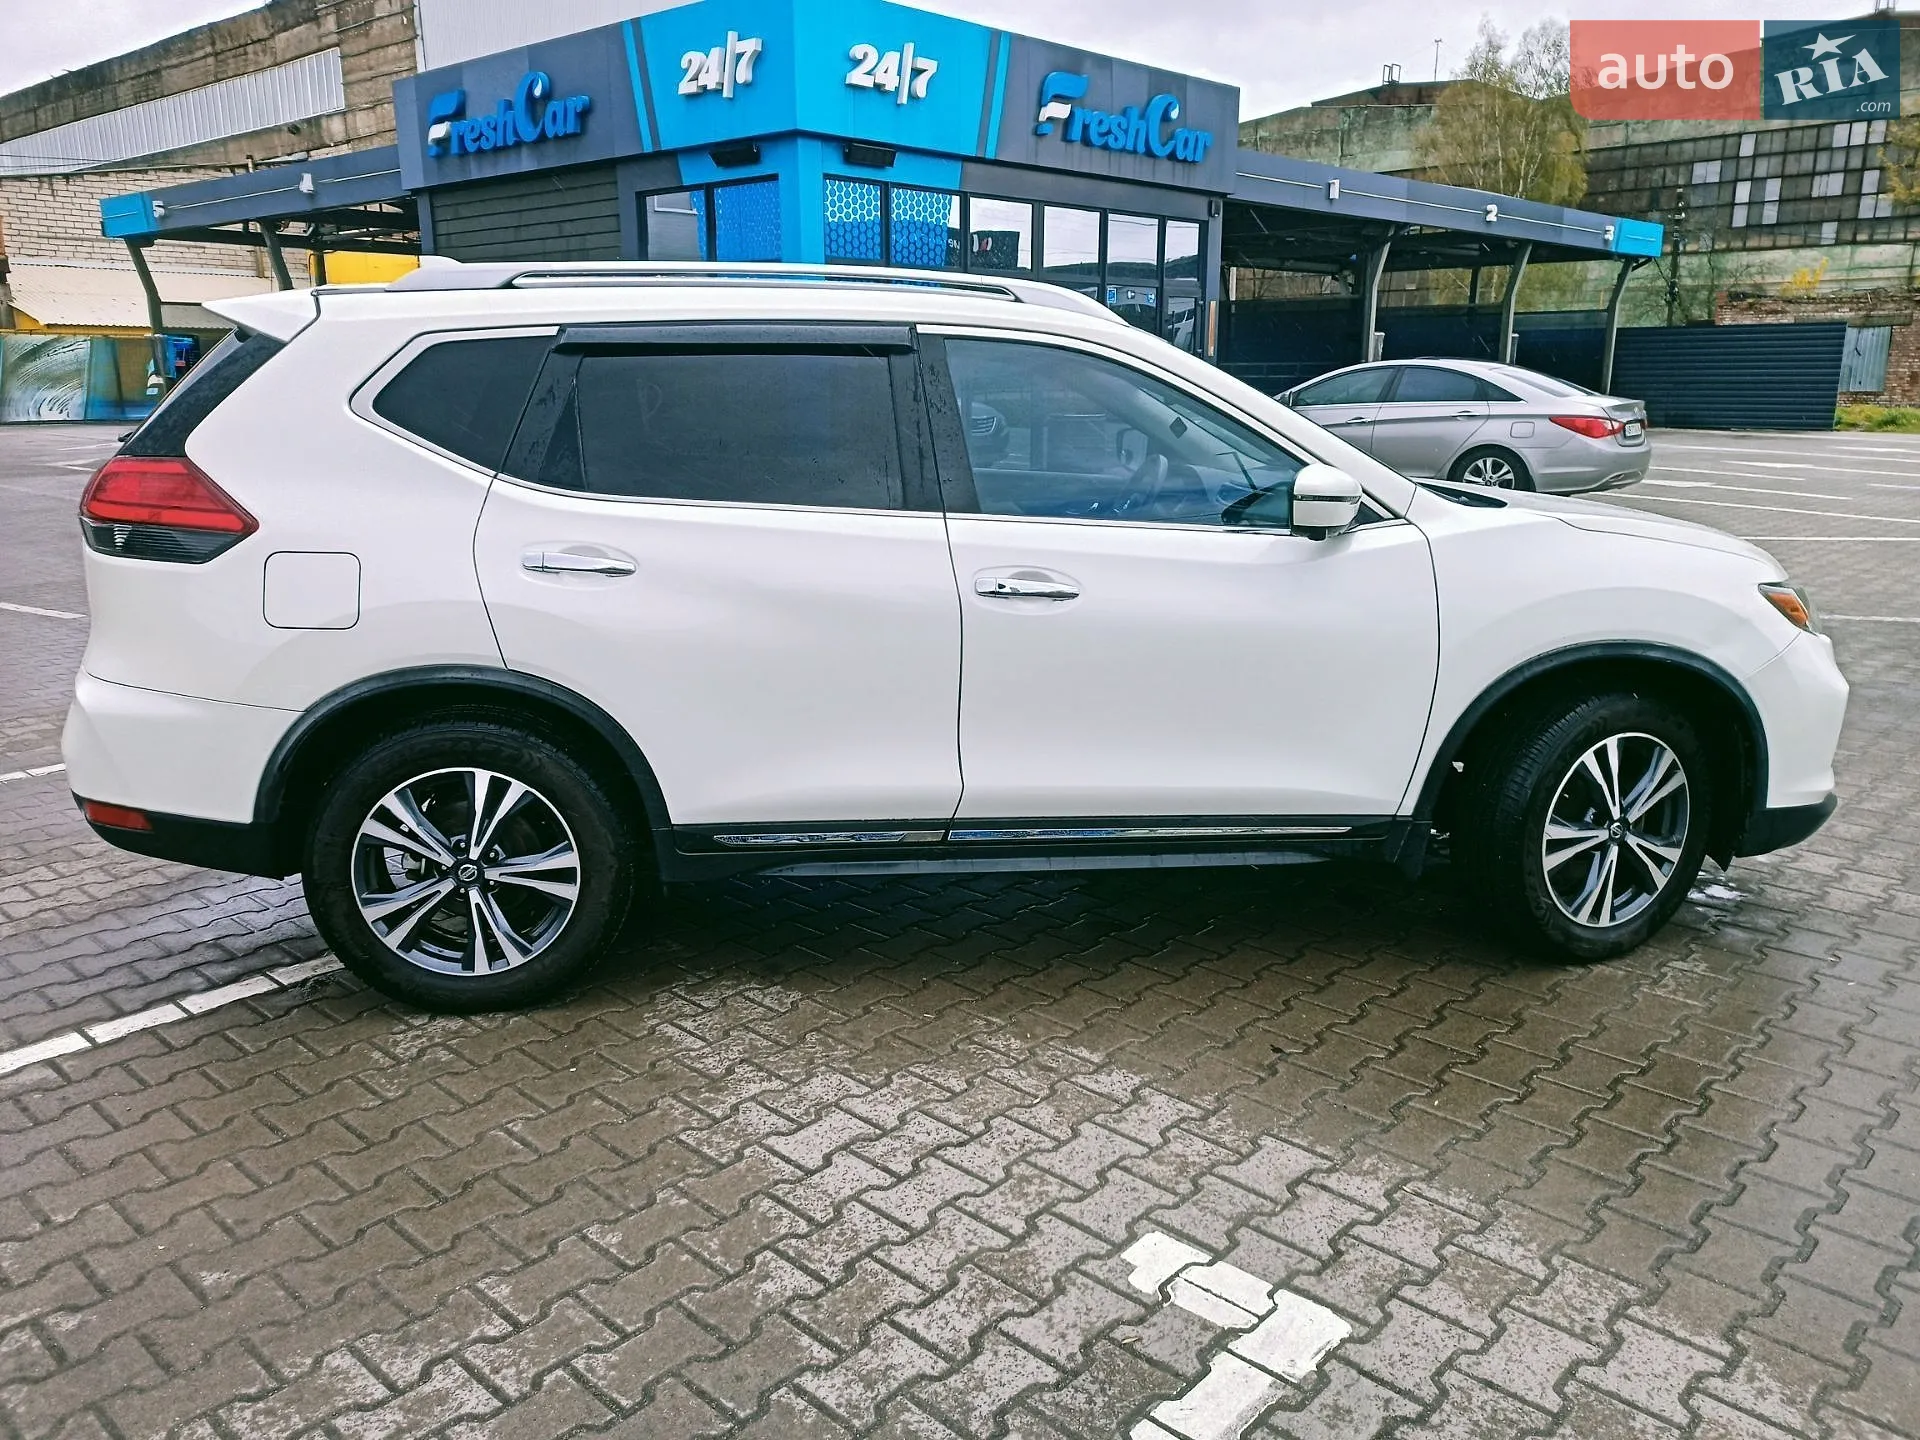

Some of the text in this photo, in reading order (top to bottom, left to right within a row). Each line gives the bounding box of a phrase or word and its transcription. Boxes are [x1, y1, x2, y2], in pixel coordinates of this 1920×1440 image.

[428, 71, 592, 158] FreshCar
[1035, 71, 1215, 163] FreshCar
[151, 200, 166, 219] 5
[1485, 204, 1498, 222] 2
[1603, 225, 1616, 241] 3
